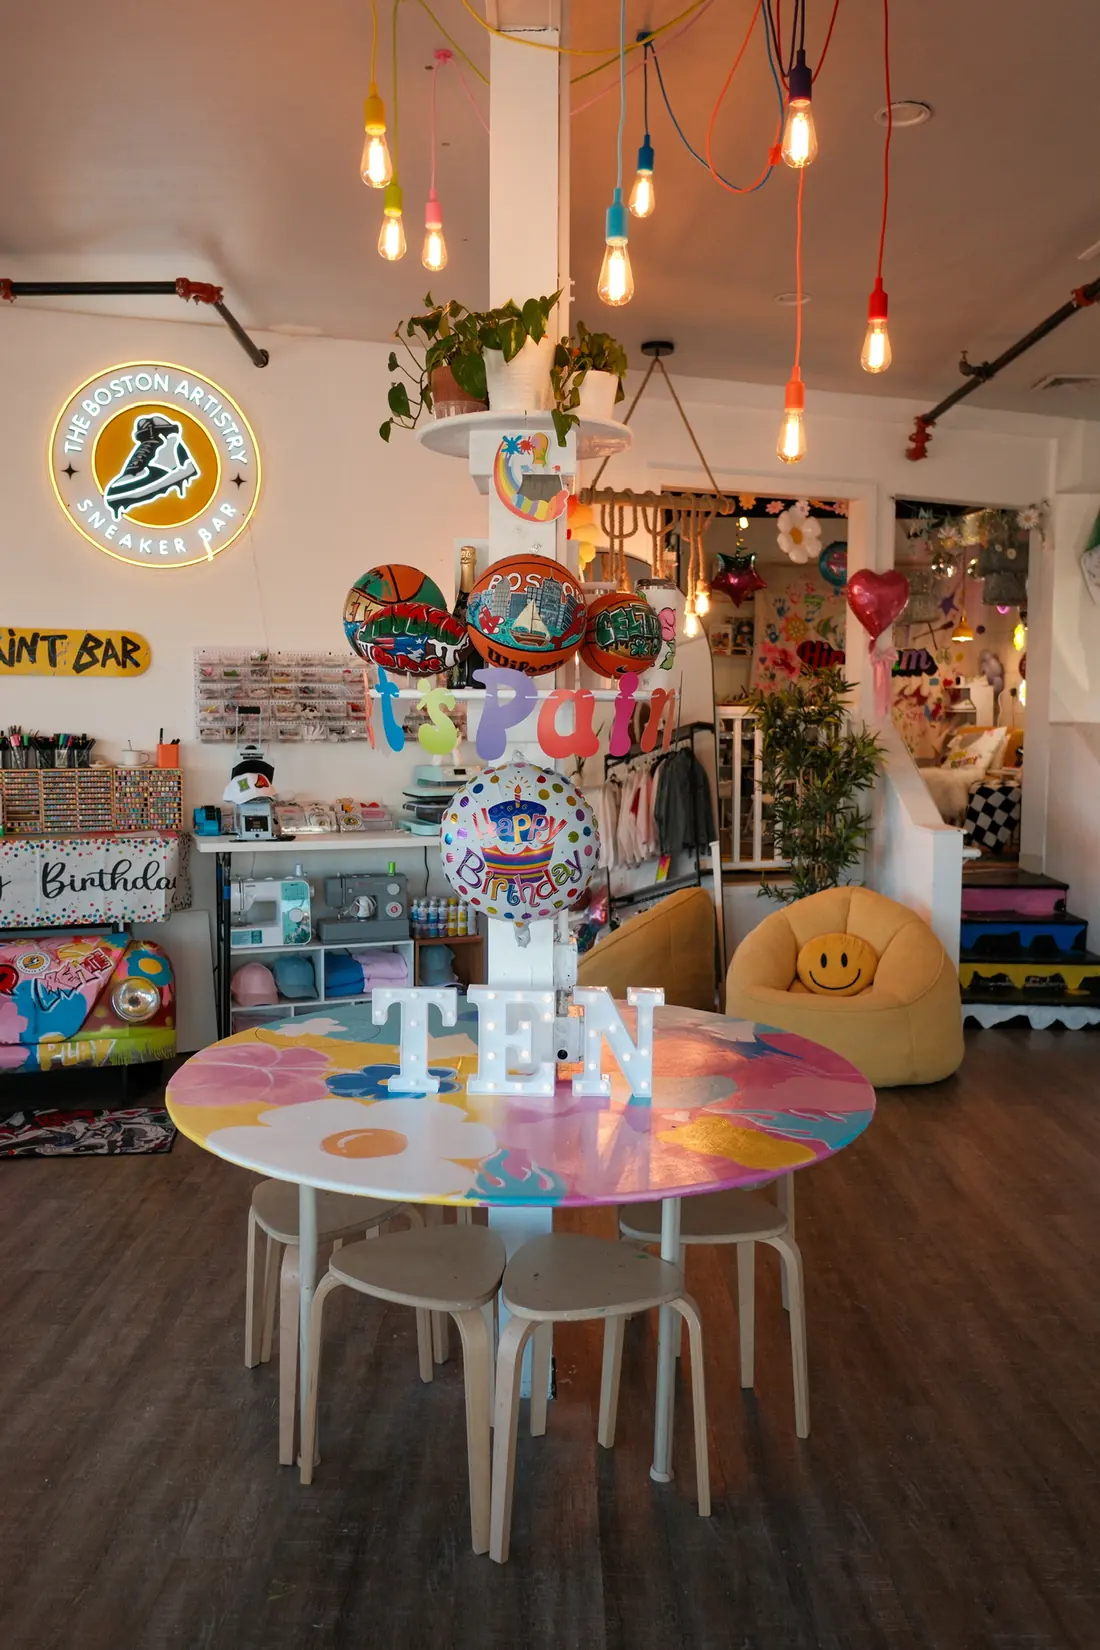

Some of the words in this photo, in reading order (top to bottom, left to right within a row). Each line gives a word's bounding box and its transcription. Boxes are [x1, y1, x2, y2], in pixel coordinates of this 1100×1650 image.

[64, 413, 91, 454] THE
[82, 372, 170, 417] BOSTON
[173, 379, 248, 465] ARTISTRY
[76, 498, 188, 556] SNEAKER
[197, 502, 237, 547] BAR
[72, 633, 141, 674] BAR
[488, 646, 564, 673] Wilson
[472, 808, 569, 845] Happy
[456, 847, 583, 907] Birthday
[372, 985, 665, 1098] TEN
